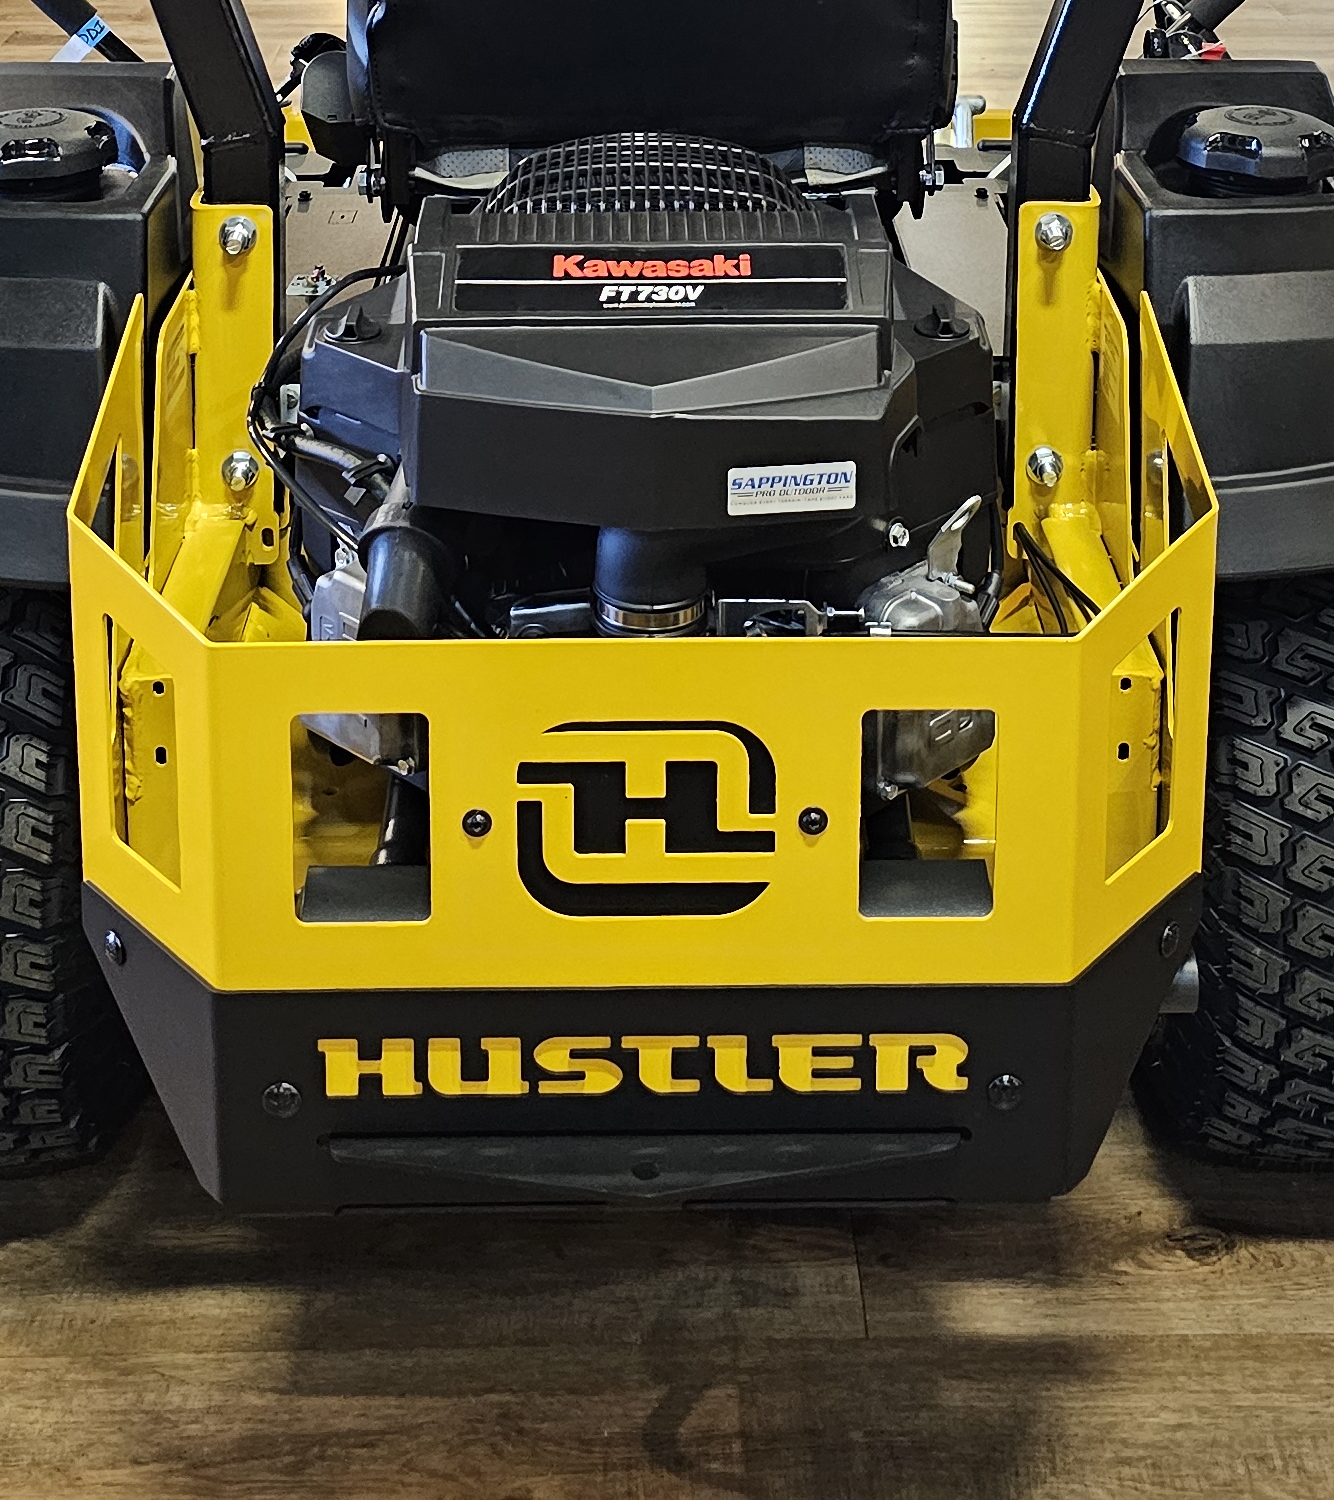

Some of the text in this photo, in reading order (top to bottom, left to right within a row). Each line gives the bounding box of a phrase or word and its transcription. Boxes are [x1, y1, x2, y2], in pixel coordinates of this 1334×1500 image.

[552, 254, 751, 278] Kawasaki
[598, 285, 705, 301] FT730V
[730, 471, 854, 491] SAPPINGTON
[754, 486, 826, 498] PRO OUTDOOR
[317, 1033, 969, 1098] HUSTLER
